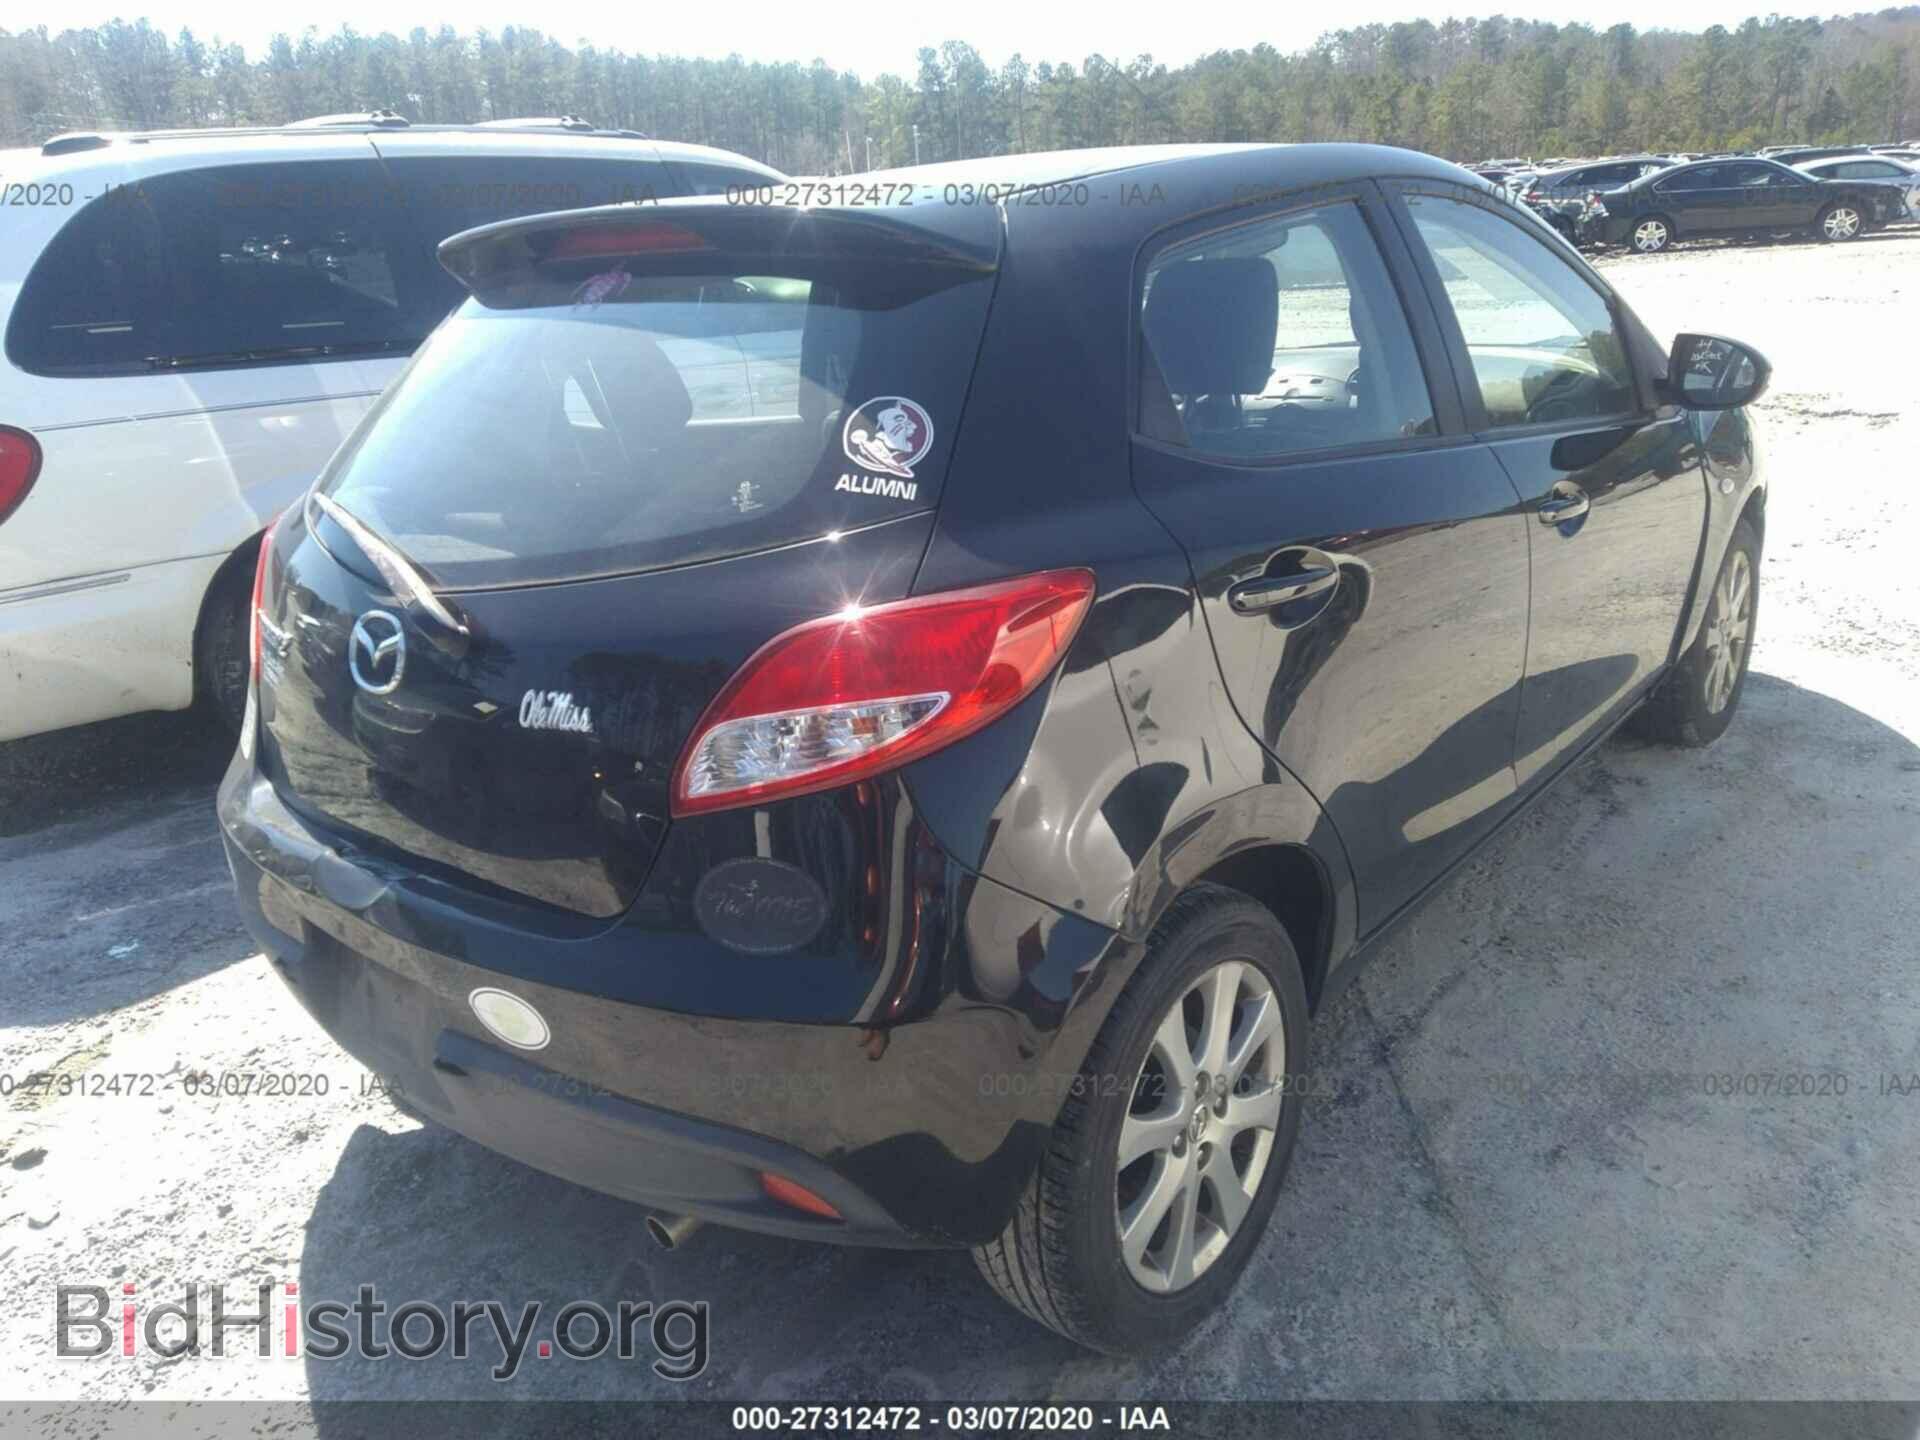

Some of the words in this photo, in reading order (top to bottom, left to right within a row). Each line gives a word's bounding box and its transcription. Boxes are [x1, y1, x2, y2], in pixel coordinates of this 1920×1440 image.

[835, 473, 918, 501] ALUMNI
[519, 688, 546, 729] Ole
[547, 691, 593, 733] Miss
